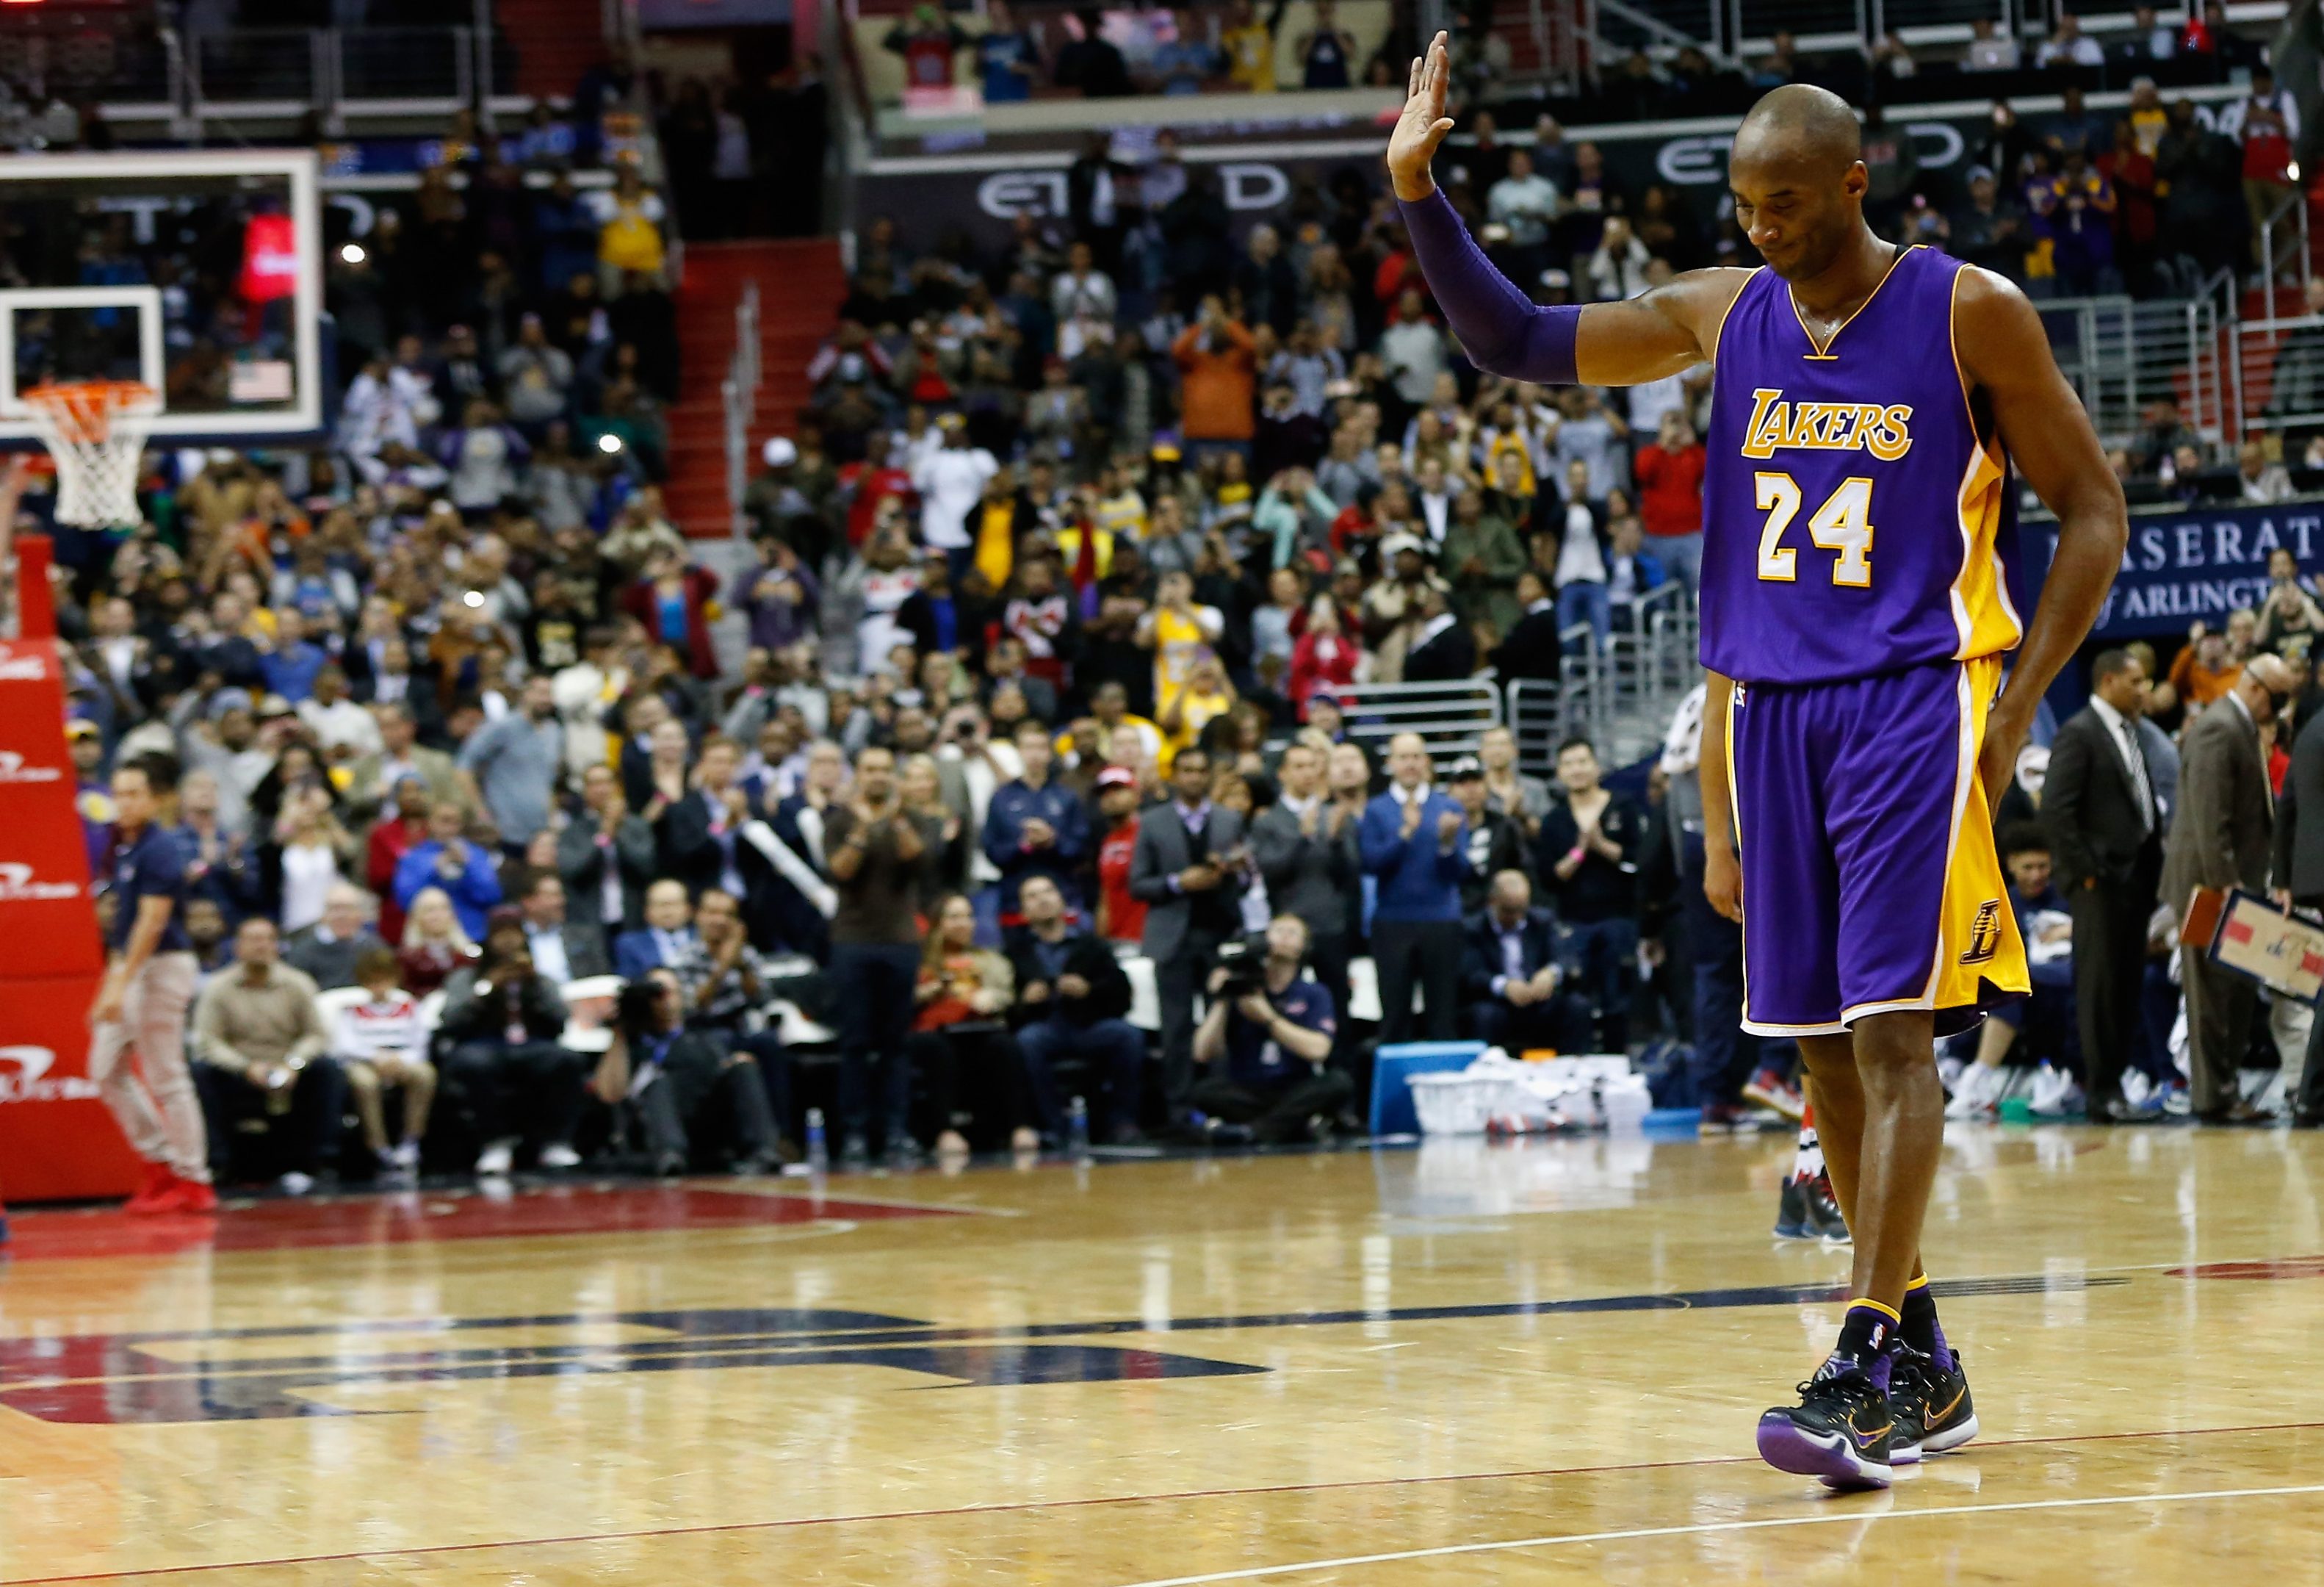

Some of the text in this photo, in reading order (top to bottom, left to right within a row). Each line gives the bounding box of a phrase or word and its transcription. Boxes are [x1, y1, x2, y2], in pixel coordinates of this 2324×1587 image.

[1741, 388, 1913, 461] LAKERS
[1754, 470, 1874, 588] 24
[2048, 516, 2321, 572] SERAT
[2123, 572, 2319, 619] ARLINGT
